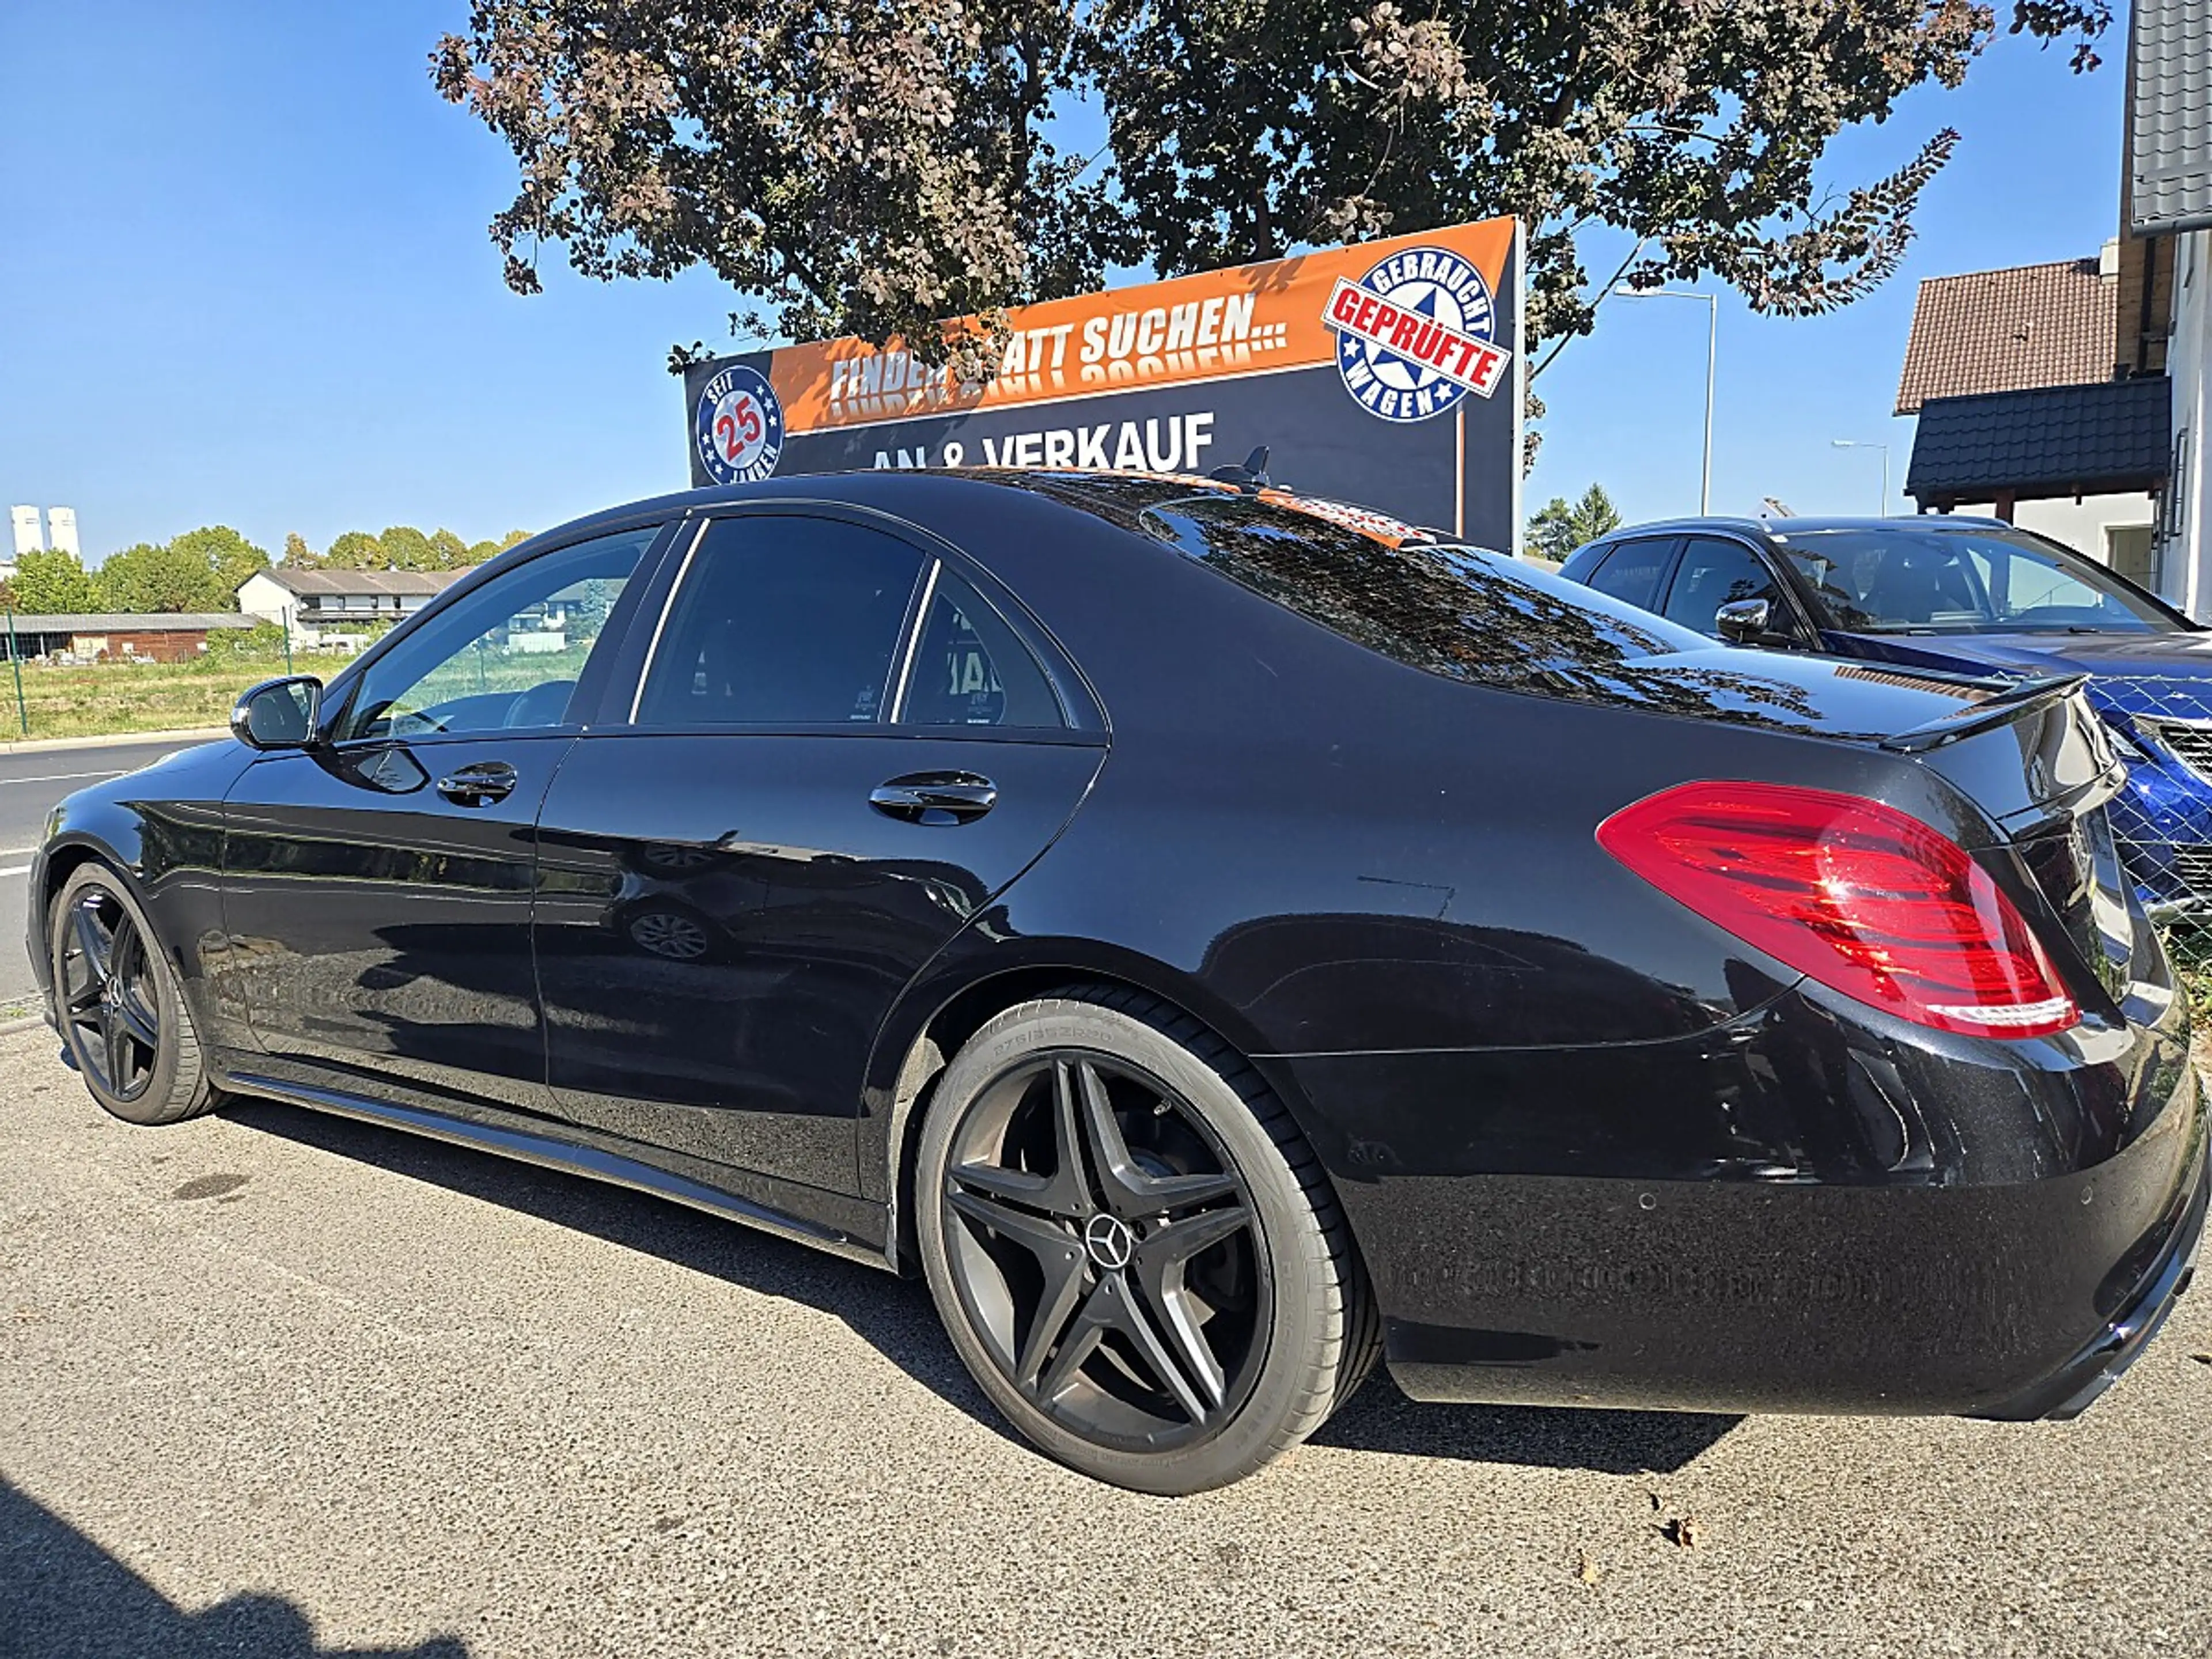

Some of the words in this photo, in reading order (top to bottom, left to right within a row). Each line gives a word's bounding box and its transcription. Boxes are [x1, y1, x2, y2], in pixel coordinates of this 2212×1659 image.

[1372, 252, 1490, 333] GEBRAUCHT
[983, 323, 1074, 377] ATT
[1080, 293, 1287, 364] SUCHEN...
[1332, 287, 1499, 388] GEPRÜFTE
[706, 372, 733, 404] SEIT
[1346, 358, 1434, 418] WAGEN
[717, 396, 760, 462] 25
[982, 412, 1214, 473] VERKAUF
[730, 444, 778, 483] JAHREN
